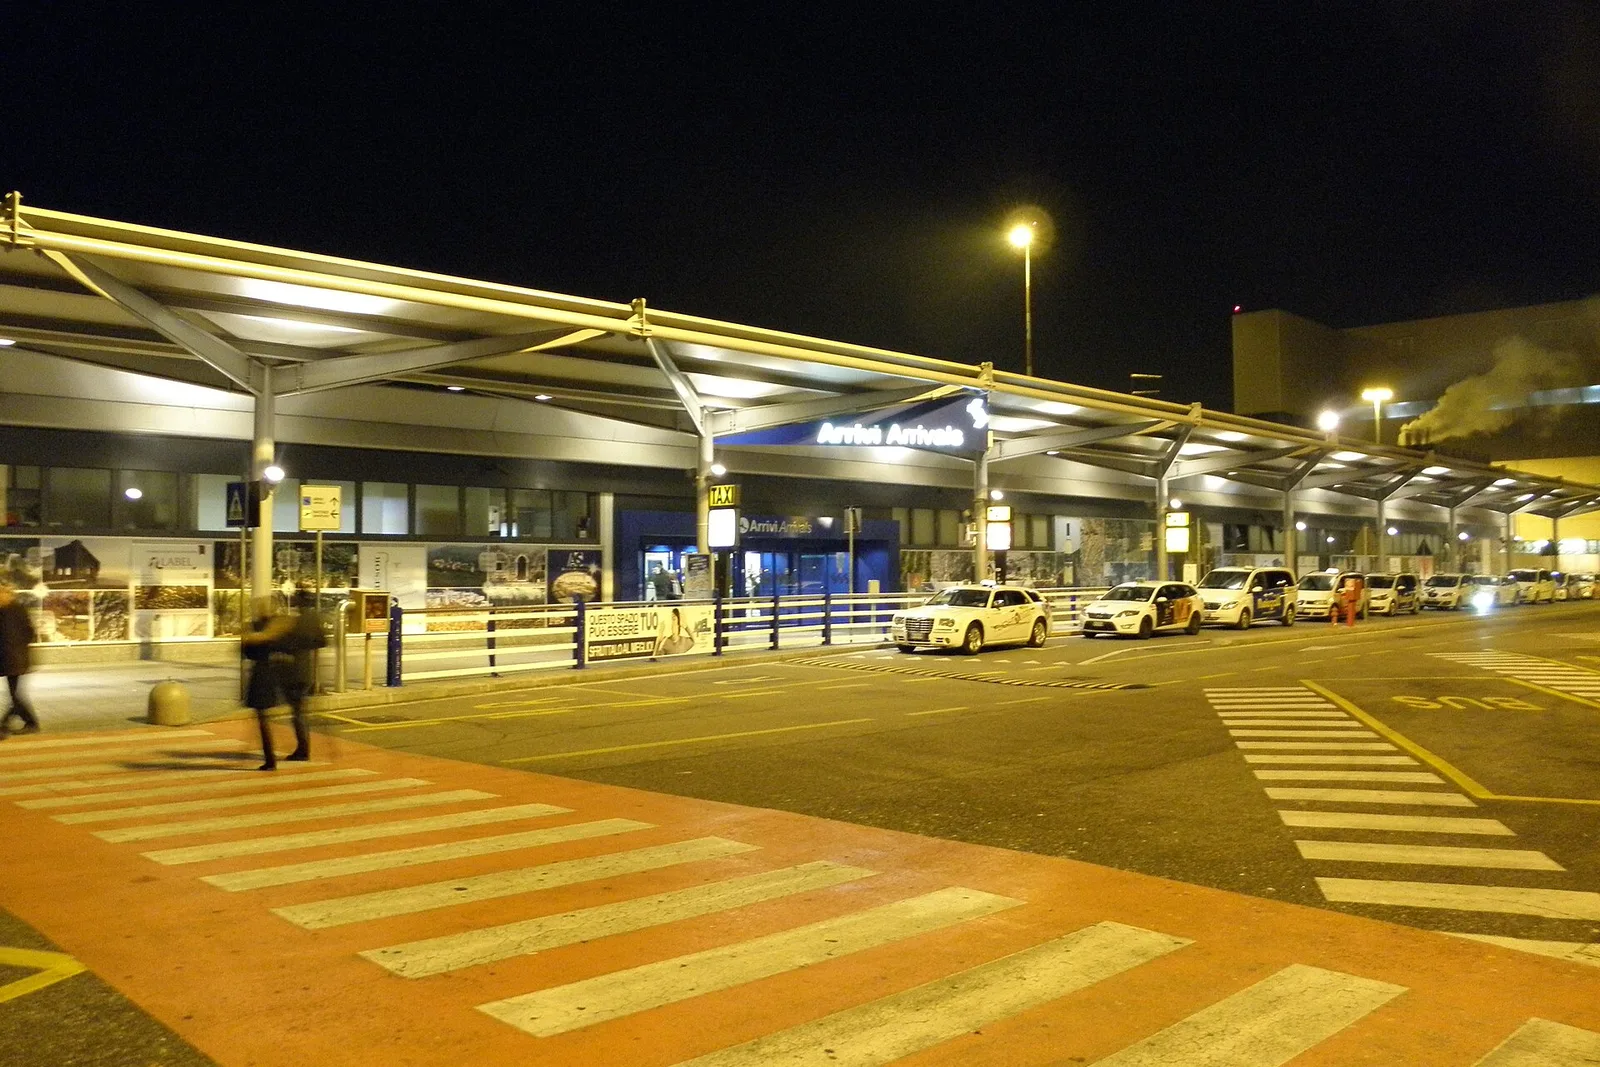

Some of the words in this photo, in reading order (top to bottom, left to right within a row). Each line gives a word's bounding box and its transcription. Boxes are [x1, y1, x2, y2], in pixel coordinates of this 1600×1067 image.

[817, 422, 882, 445] Arrivi
[886, 423, 965, 447] Arrivals
[711, 486, 734, 505] TAXI
[750, 519, 778, 533] Arrivi
[779, 520, 813, 534] Arrivals
[590, 614, 615, 626] QUESTO
[617, 612, 638, 624] SPAZIO
[640, 612, 659, 631] TUO
[607, 624, 639, 637] ESSERE
[1391, 695, 1547, 710] BUS
